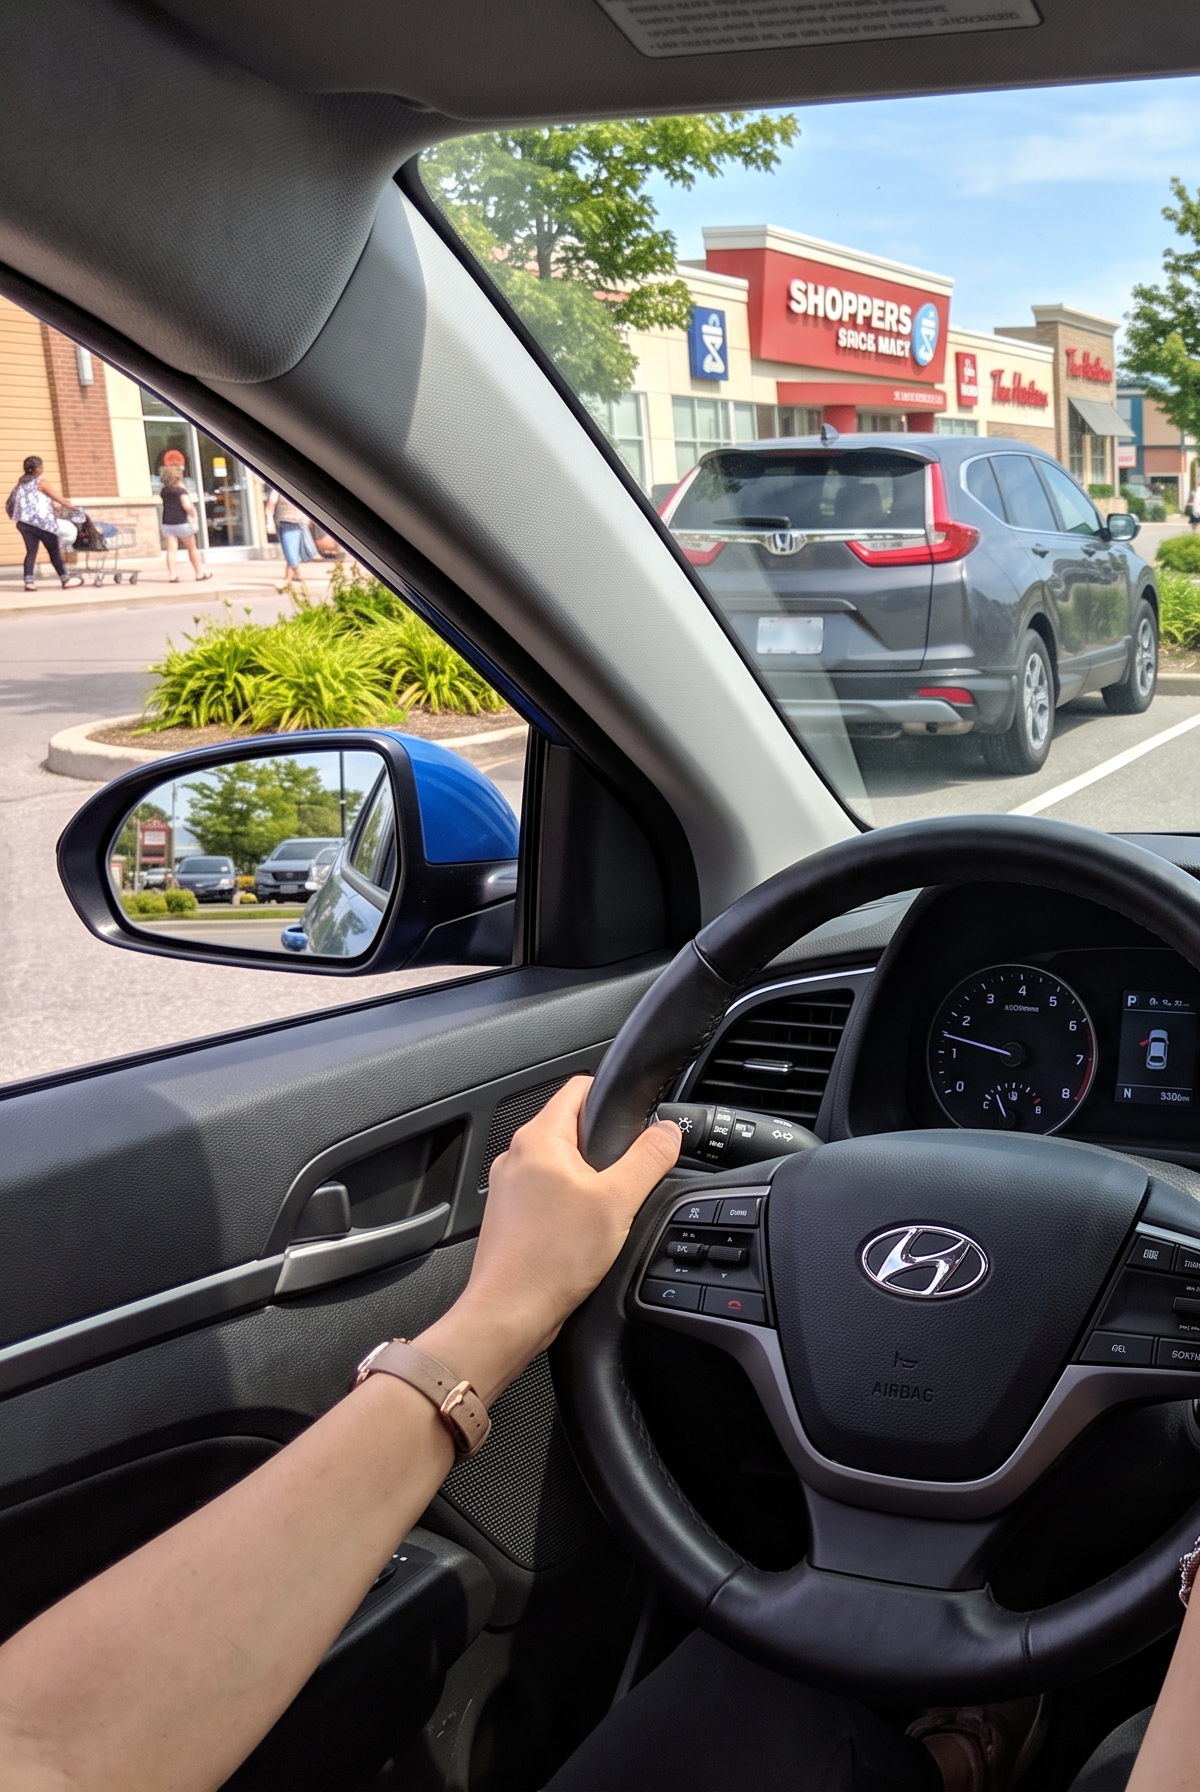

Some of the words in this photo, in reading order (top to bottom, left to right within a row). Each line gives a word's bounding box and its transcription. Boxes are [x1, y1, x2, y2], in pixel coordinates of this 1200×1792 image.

[789, 278, 913, 336] SHOPPERS
[1018, 985, 1027, 996] 4
[986, 993, 995, 1004] 3
[1049, 996, 1057, 1007] 5
[1127, 995, 1137, 1007] P
[962, 1015, 971, 1026] 2
[1068, 1020, 1077, 1031] 6
[952, 1048, 957, 1059] 1
[1076, 1054, 1084, 1065] 7
[956, 1081, 964, 1092] 0
[1061, 1088, 1070, 1099] 8
[1123, 1088, 1132, 1099] N
[871, 1381, 934, 1403] AIRBAG
